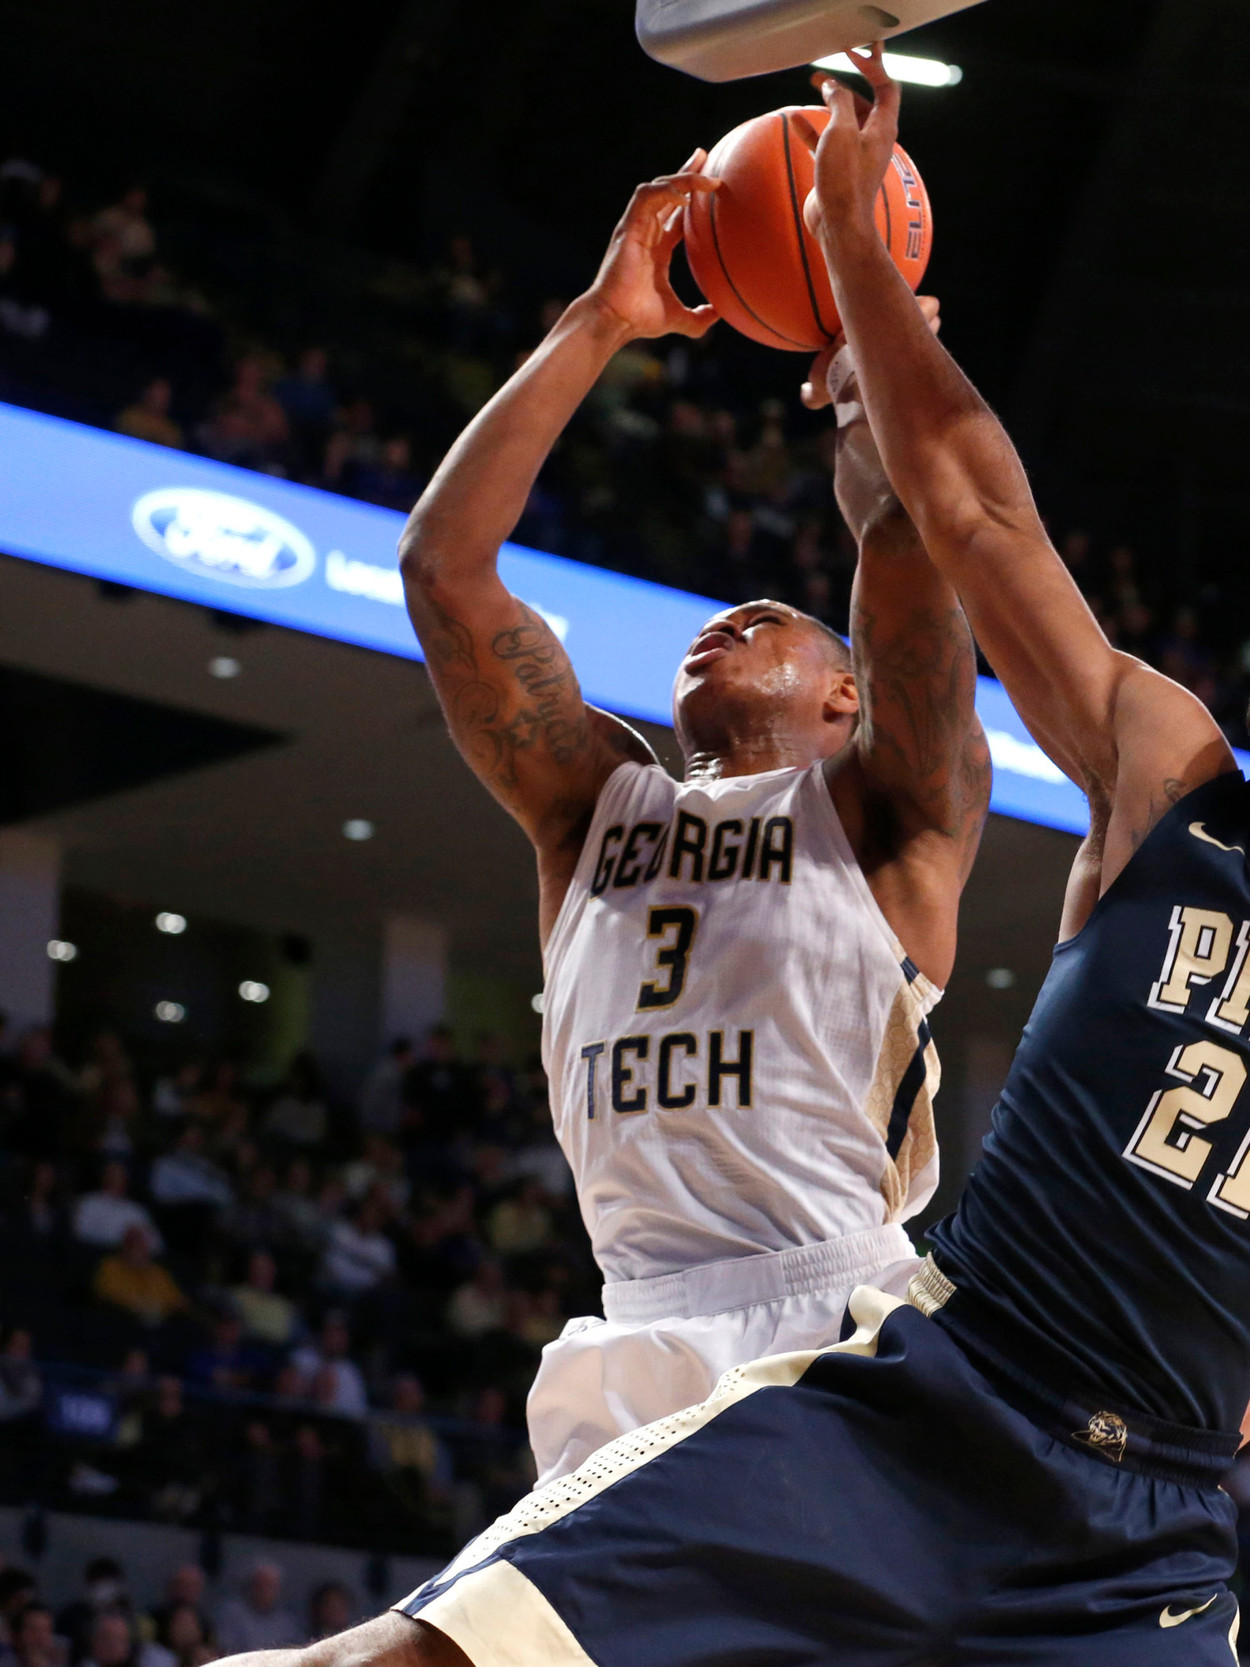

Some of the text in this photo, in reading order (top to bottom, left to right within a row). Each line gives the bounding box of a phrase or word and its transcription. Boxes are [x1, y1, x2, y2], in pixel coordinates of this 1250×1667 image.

[588, 808, 794, 901] GEORGIA
[636, 904, 699, 1014] 3
[580, 1029, 754, 1122] TECH
